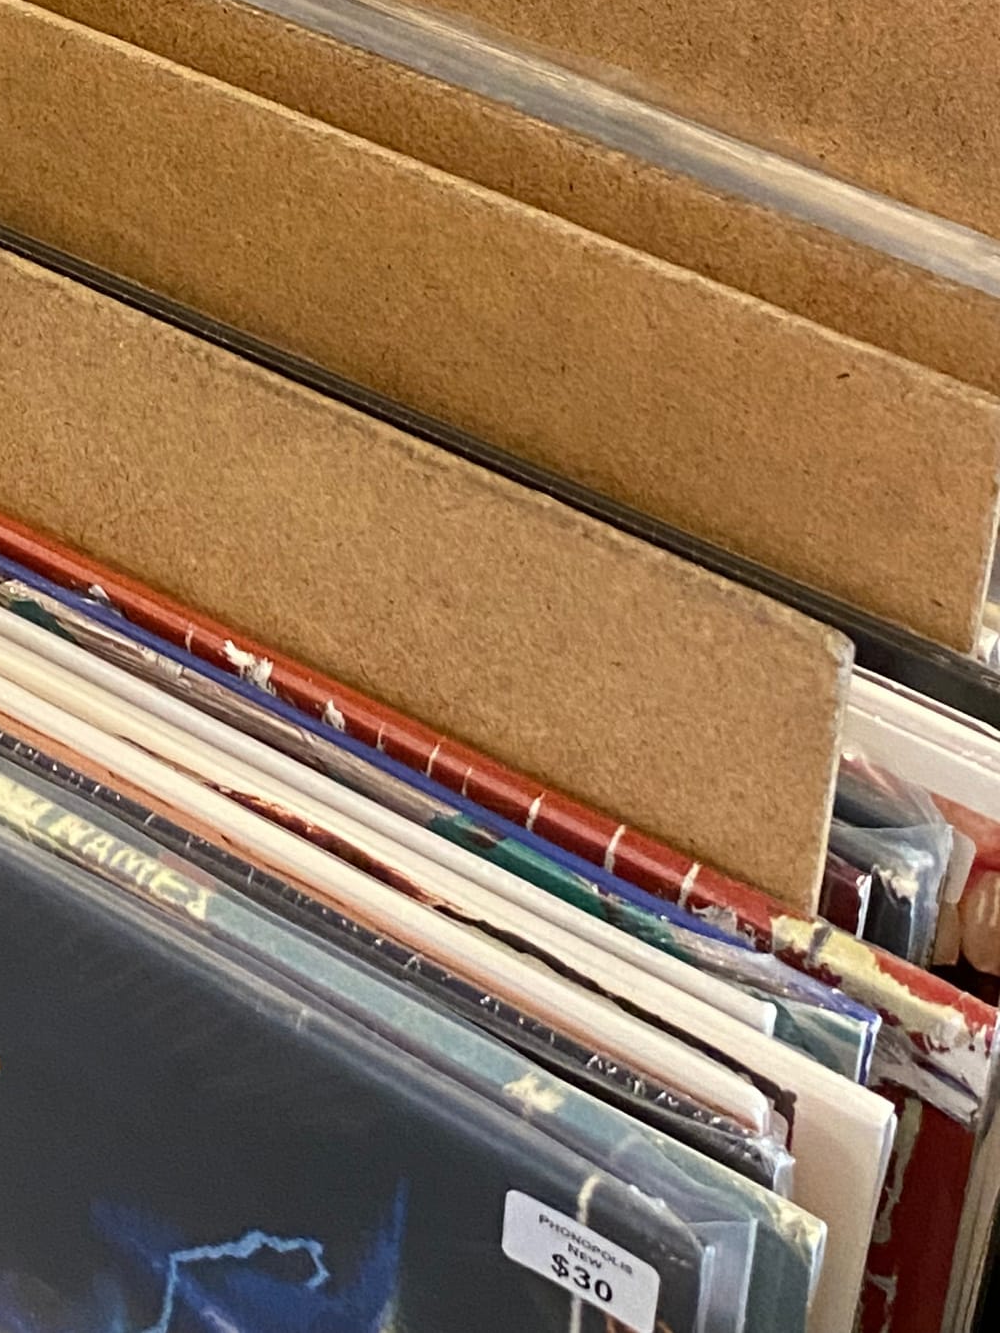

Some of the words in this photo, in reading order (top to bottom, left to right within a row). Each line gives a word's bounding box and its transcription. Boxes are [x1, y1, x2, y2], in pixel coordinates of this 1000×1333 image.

[539, 1214, 633, 1275] PHONOPOLIS
[567, 1243, 602, 1269] NEW
[551, 1253, 613, 1302] $30
